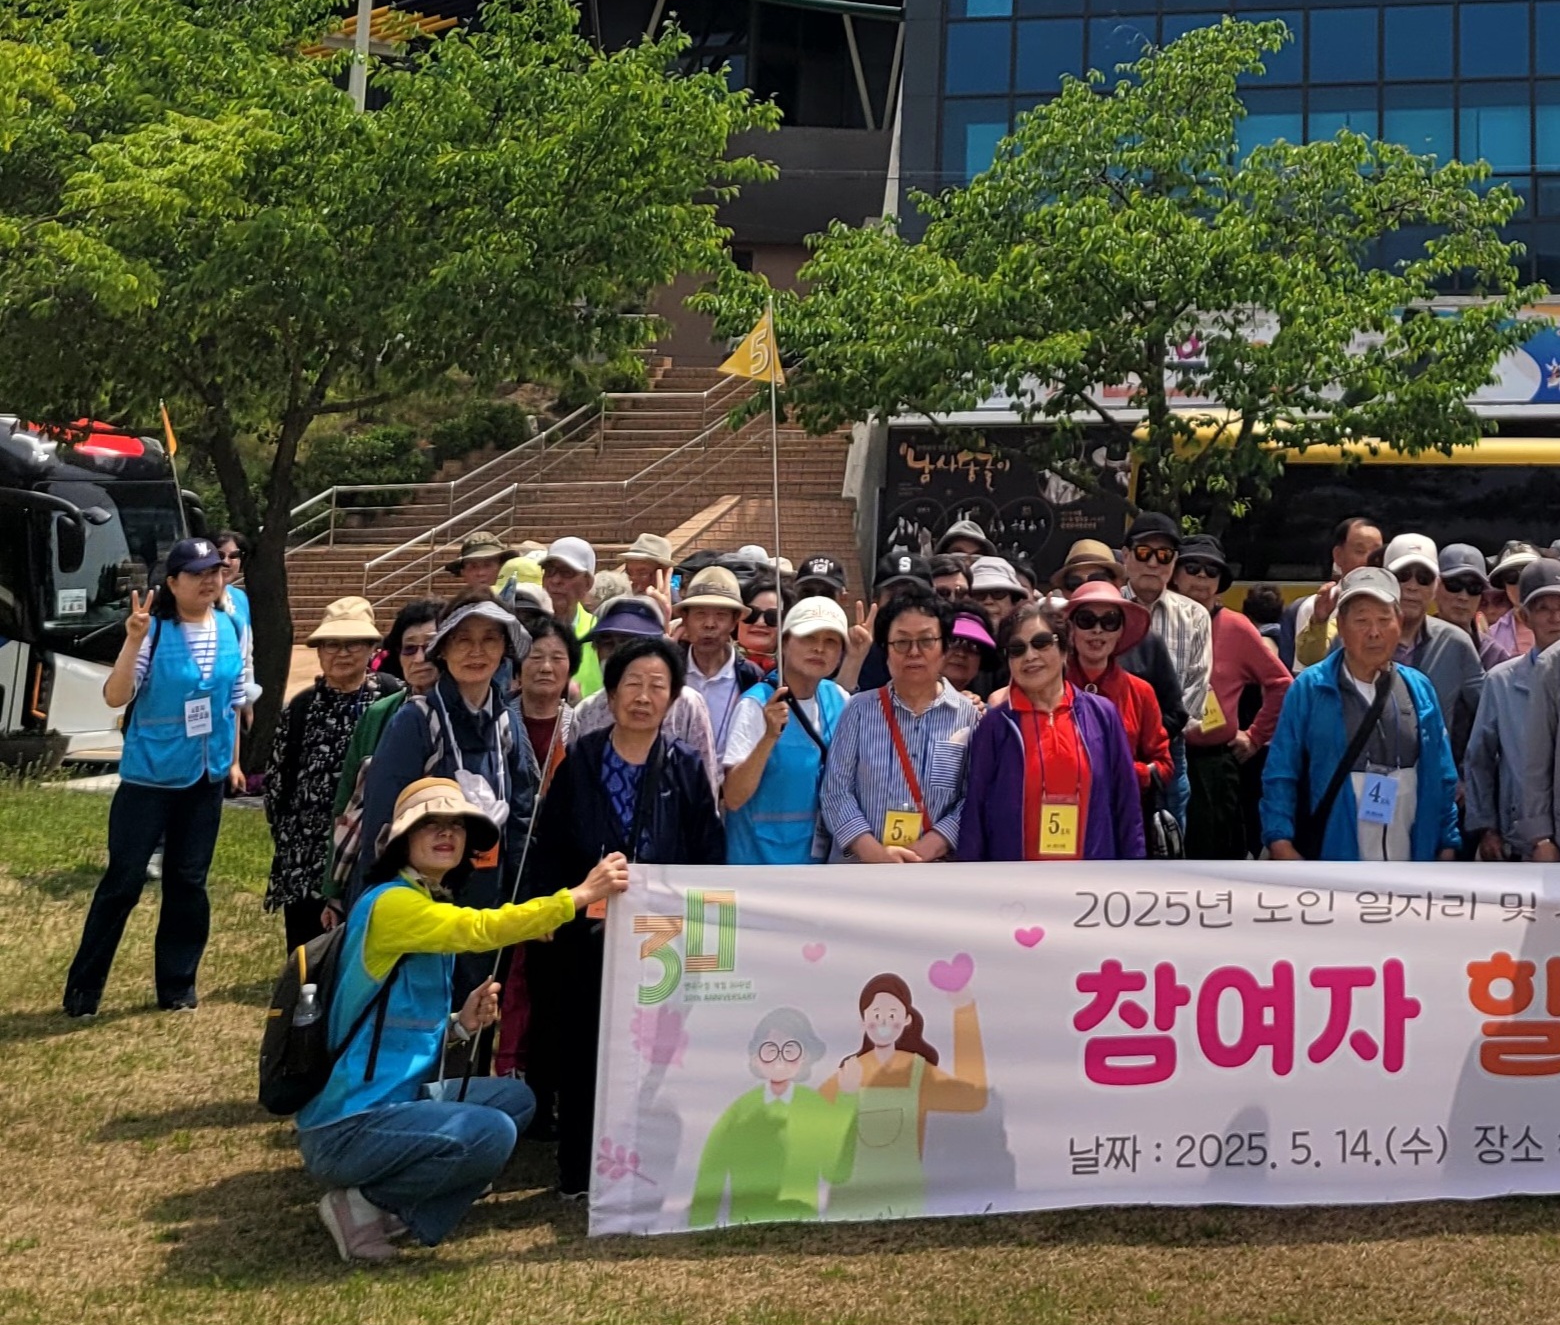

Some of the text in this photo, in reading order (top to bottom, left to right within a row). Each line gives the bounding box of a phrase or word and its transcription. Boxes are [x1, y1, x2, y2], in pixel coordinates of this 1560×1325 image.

[750, 328, 770, 377] 5
[899, 556, 912, 573] S
[1073, 889, 1234, 928] 2025년
[1252, 889, 1335, 925] 노인
[1354, 889, 1476, 922] 일자리
[1499, 890, 1538, 923] 및
[1072, 957, 1422, 1087] 참여자
[1337, 1124, 1449, 1168] 14.(수)
